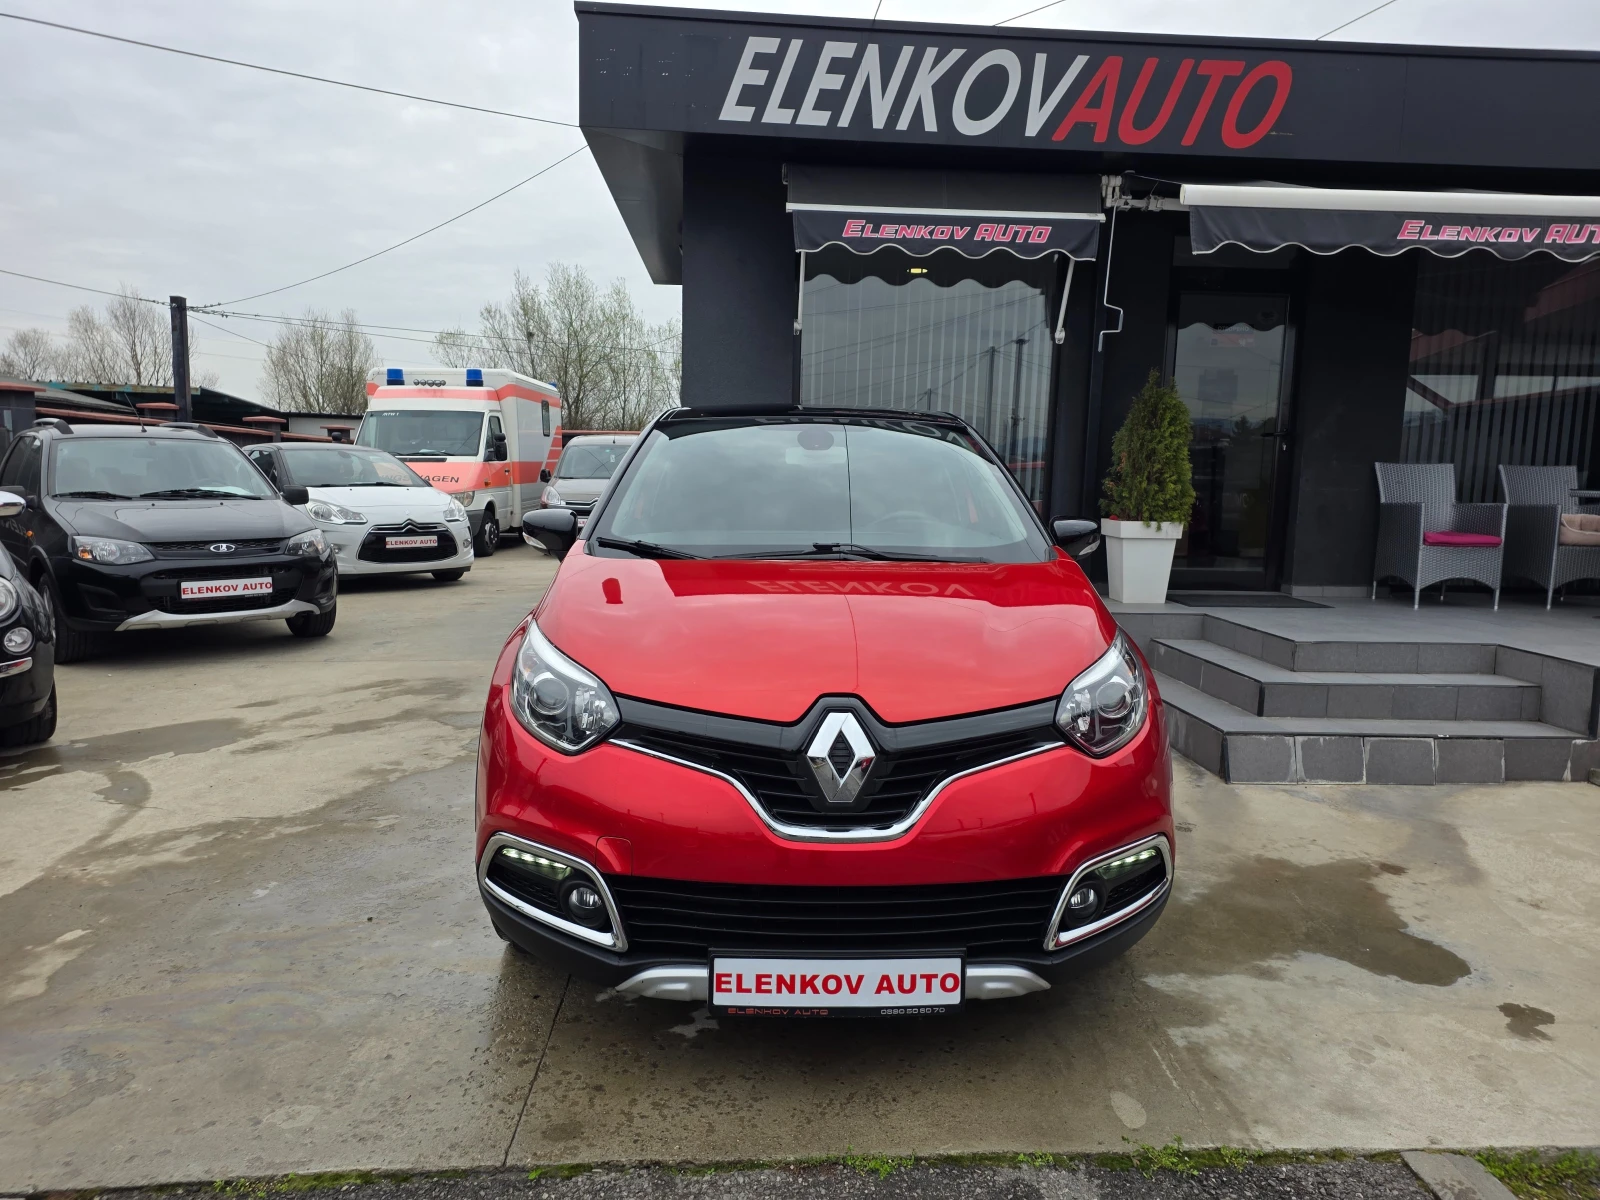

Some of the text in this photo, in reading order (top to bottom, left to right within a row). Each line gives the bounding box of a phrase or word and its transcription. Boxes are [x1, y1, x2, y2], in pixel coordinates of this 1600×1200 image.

[974, 223, 1052, 243] AUTO
[182, 581, 273, 595] ELENKOV AUTO
[715, 972, 960, 995] ELENKOV AUTO
[727, 1007, 790, 1015] ELENKOV
